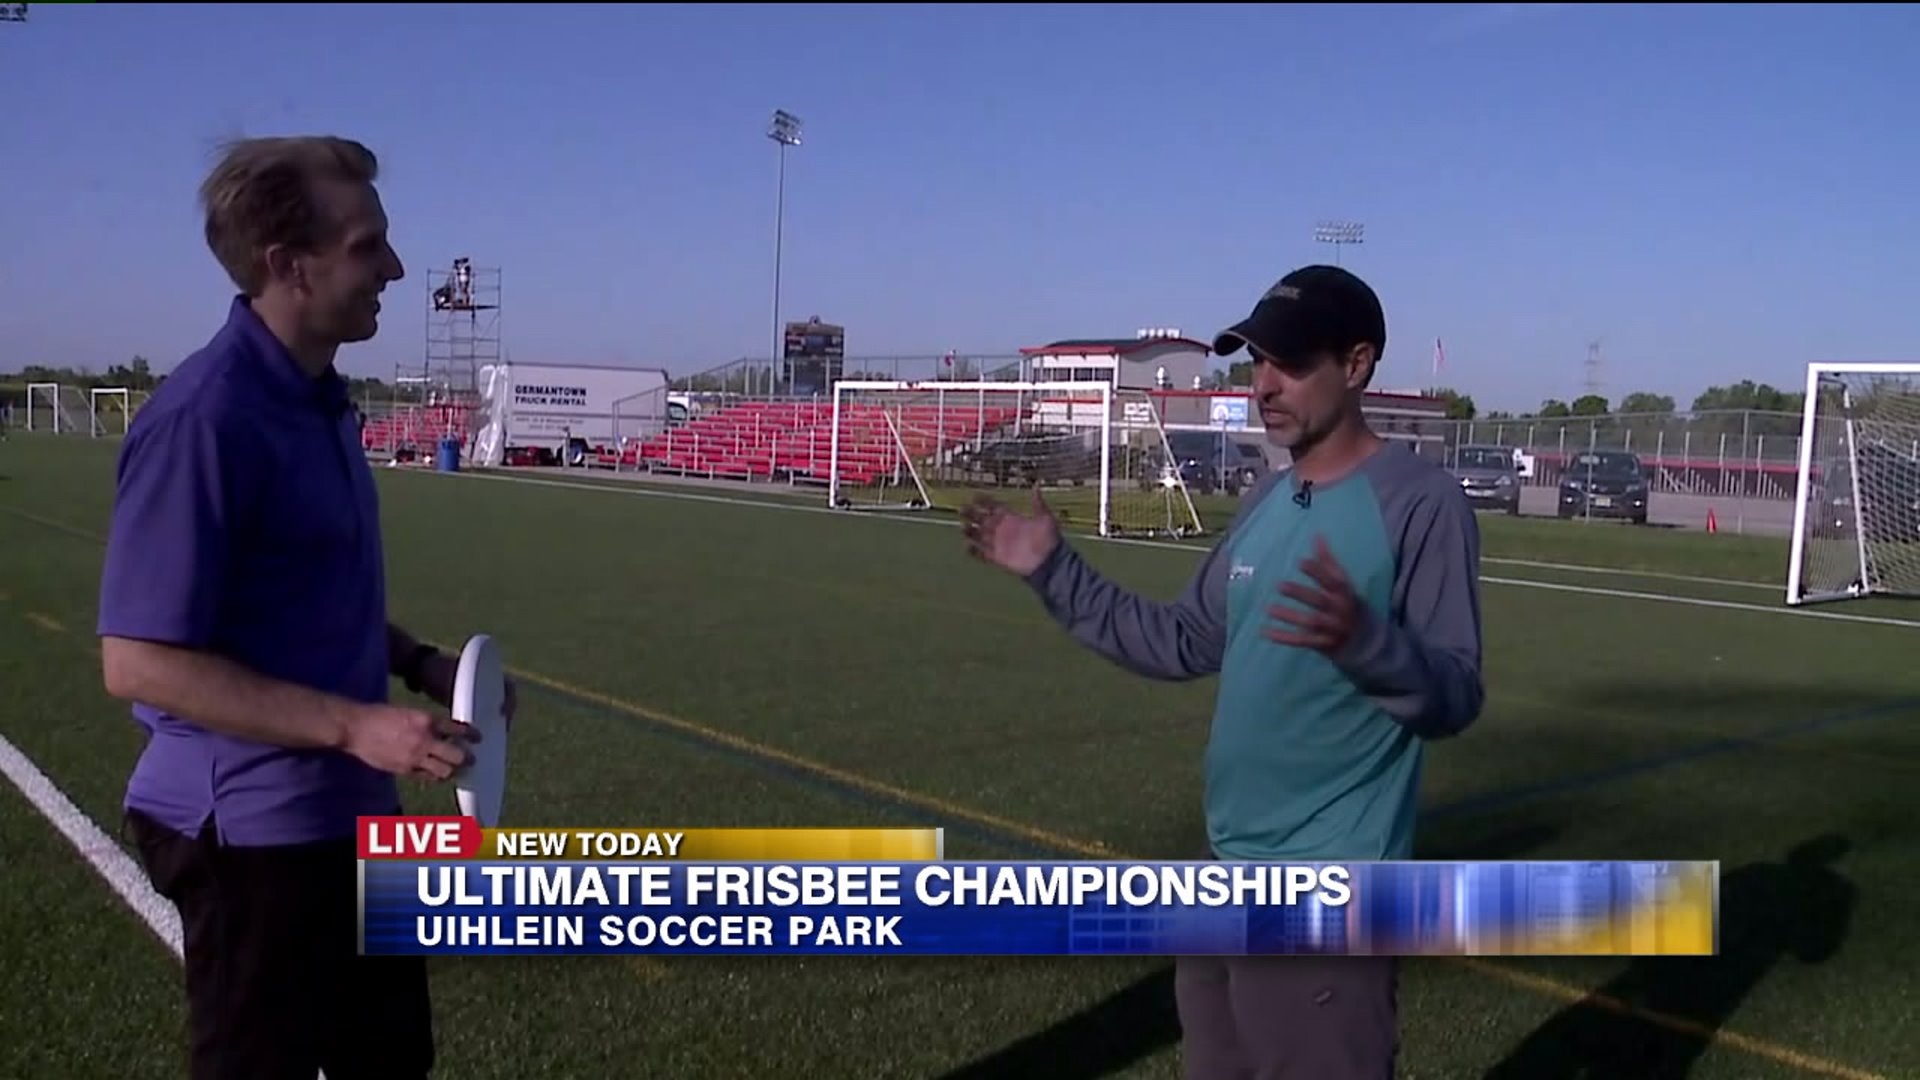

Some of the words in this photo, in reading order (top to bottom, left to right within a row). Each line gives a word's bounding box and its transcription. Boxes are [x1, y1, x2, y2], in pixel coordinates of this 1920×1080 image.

[515, 385, 586, 396] GERMANTOWN
[515, 395, 546, 405] TRUCK
[550, 397, 586, 406] RENTAL
